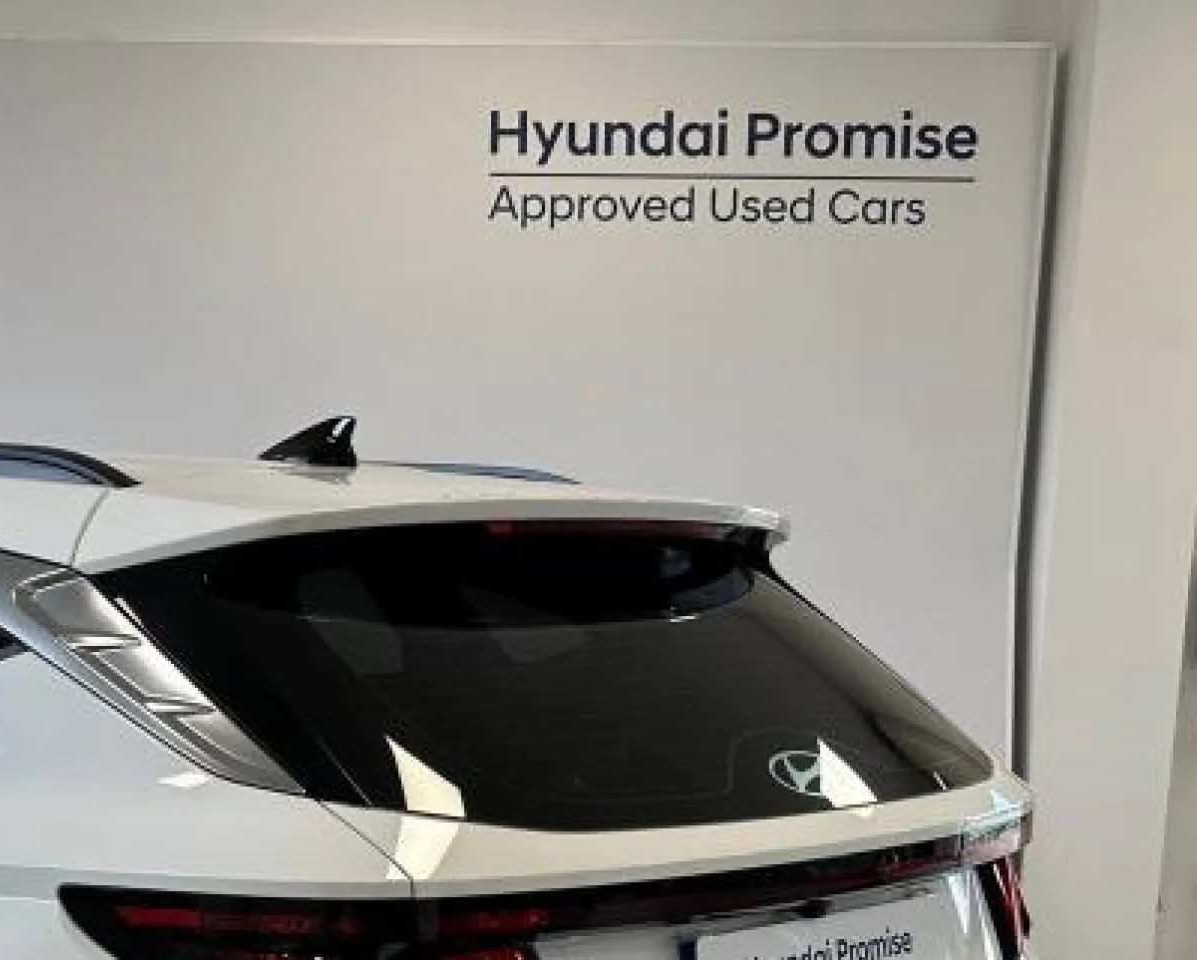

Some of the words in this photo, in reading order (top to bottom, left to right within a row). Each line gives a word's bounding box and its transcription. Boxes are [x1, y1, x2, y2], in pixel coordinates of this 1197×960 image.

[489, 109, 728, 165] Hyundai
[747, 110, 979, 160] Promise
[489, 185, 696, 229] Approved
[710, 187, 815, 224] Used
[828, 188, 926, 225] Cars
